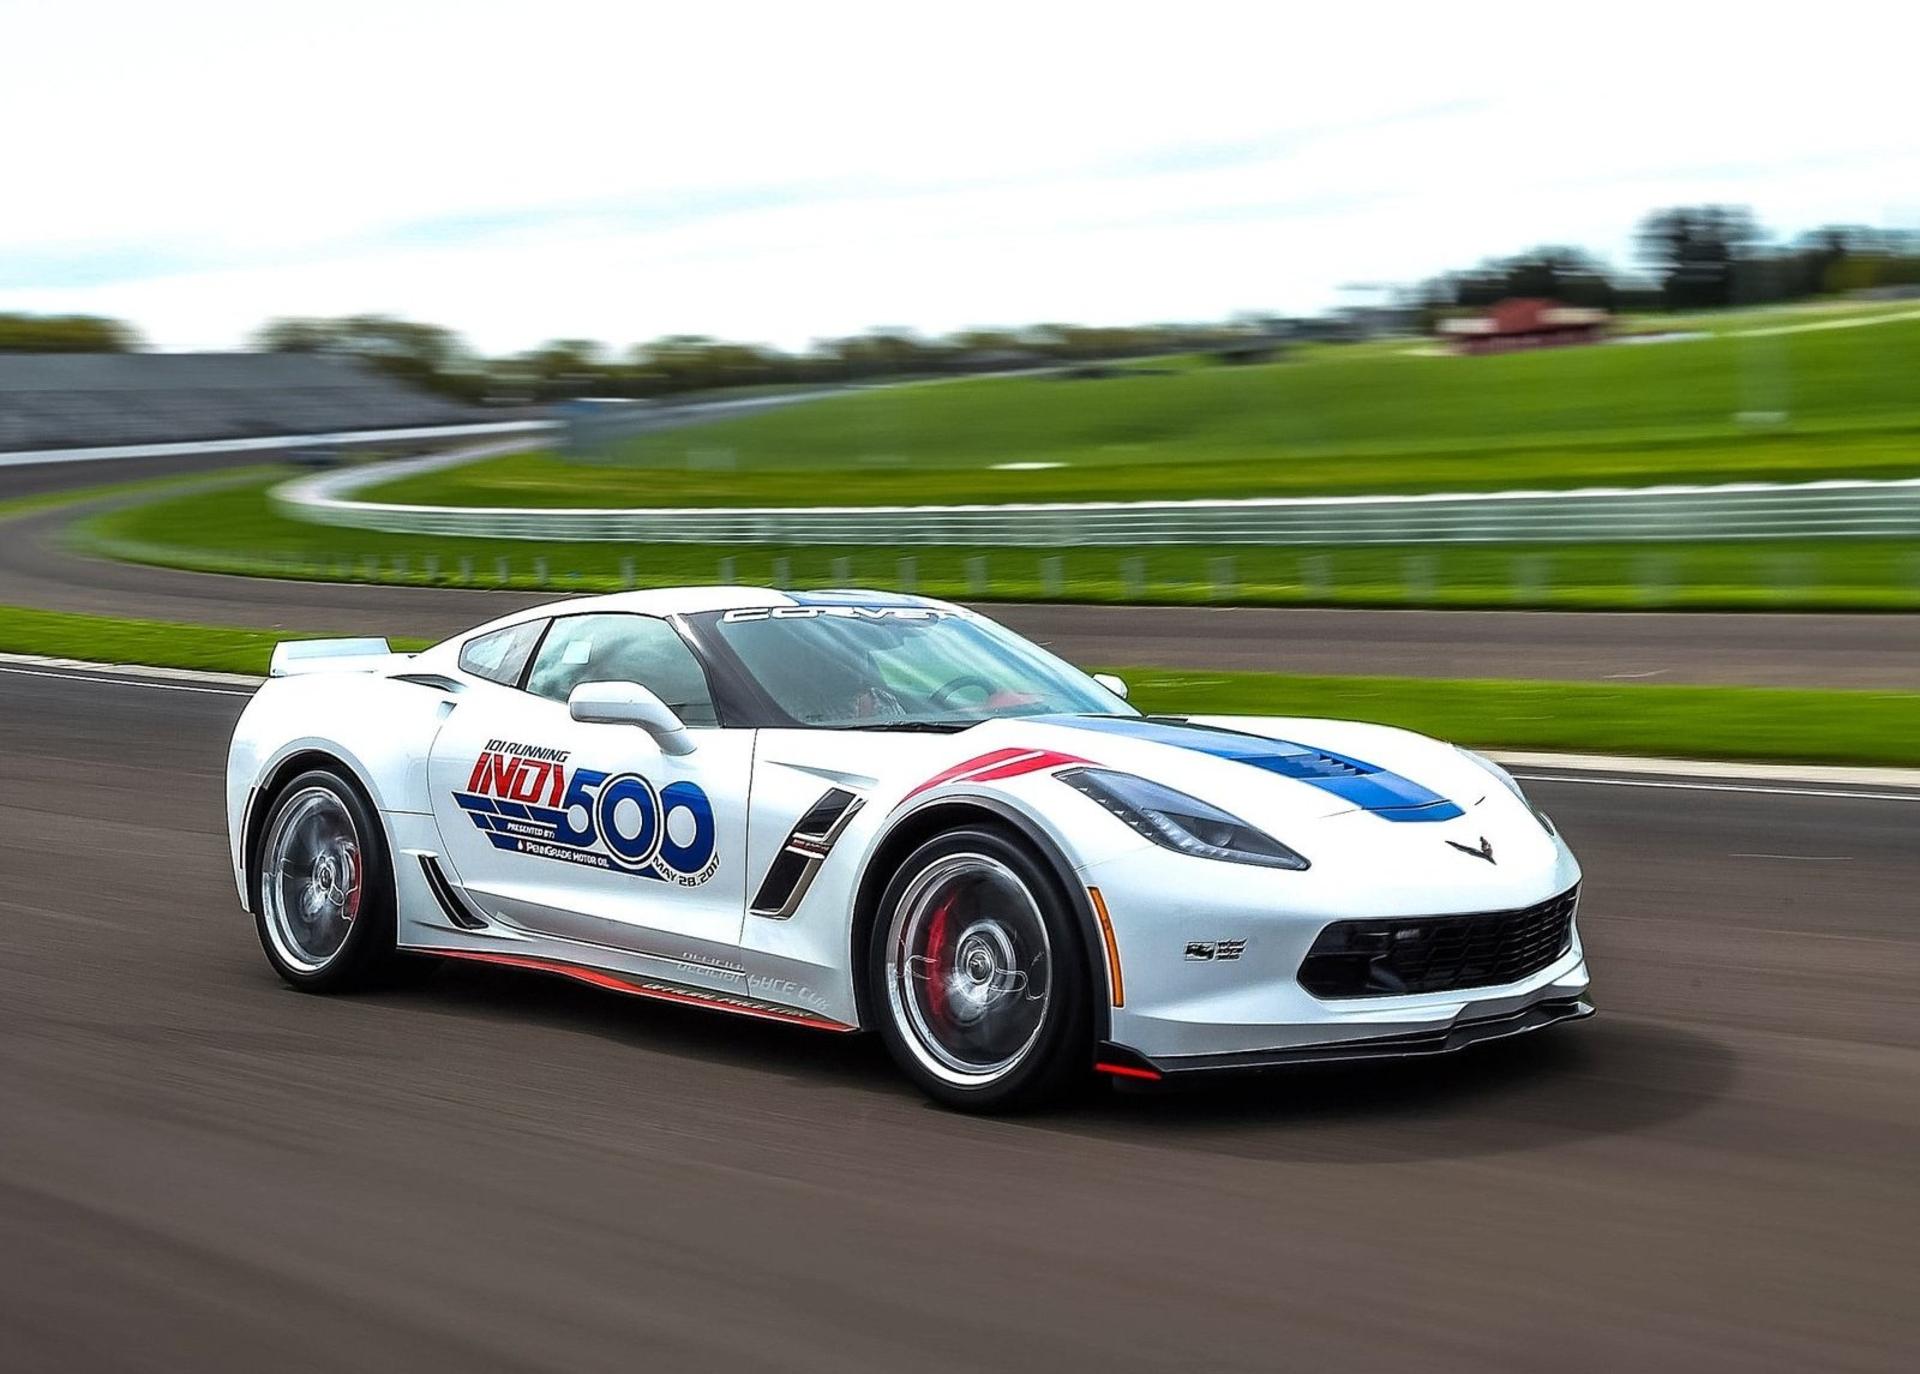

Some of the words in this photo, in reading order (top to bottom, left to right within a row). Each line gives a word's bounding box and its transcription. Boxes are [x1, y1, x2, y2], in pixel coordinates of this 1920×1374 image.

[484, 738, 507, 752] 101
[506, 741, 571, 763] RUNNING
[467, 751, 566, 808] INDY
[562, 767, 716, 874] 500
[506, 822, 543, 837] PRESENTED
[572, 852, 597, 865] MOTOR
[597, 857, 610, 868] OIL
[652, 855, 677, 882] MAY
